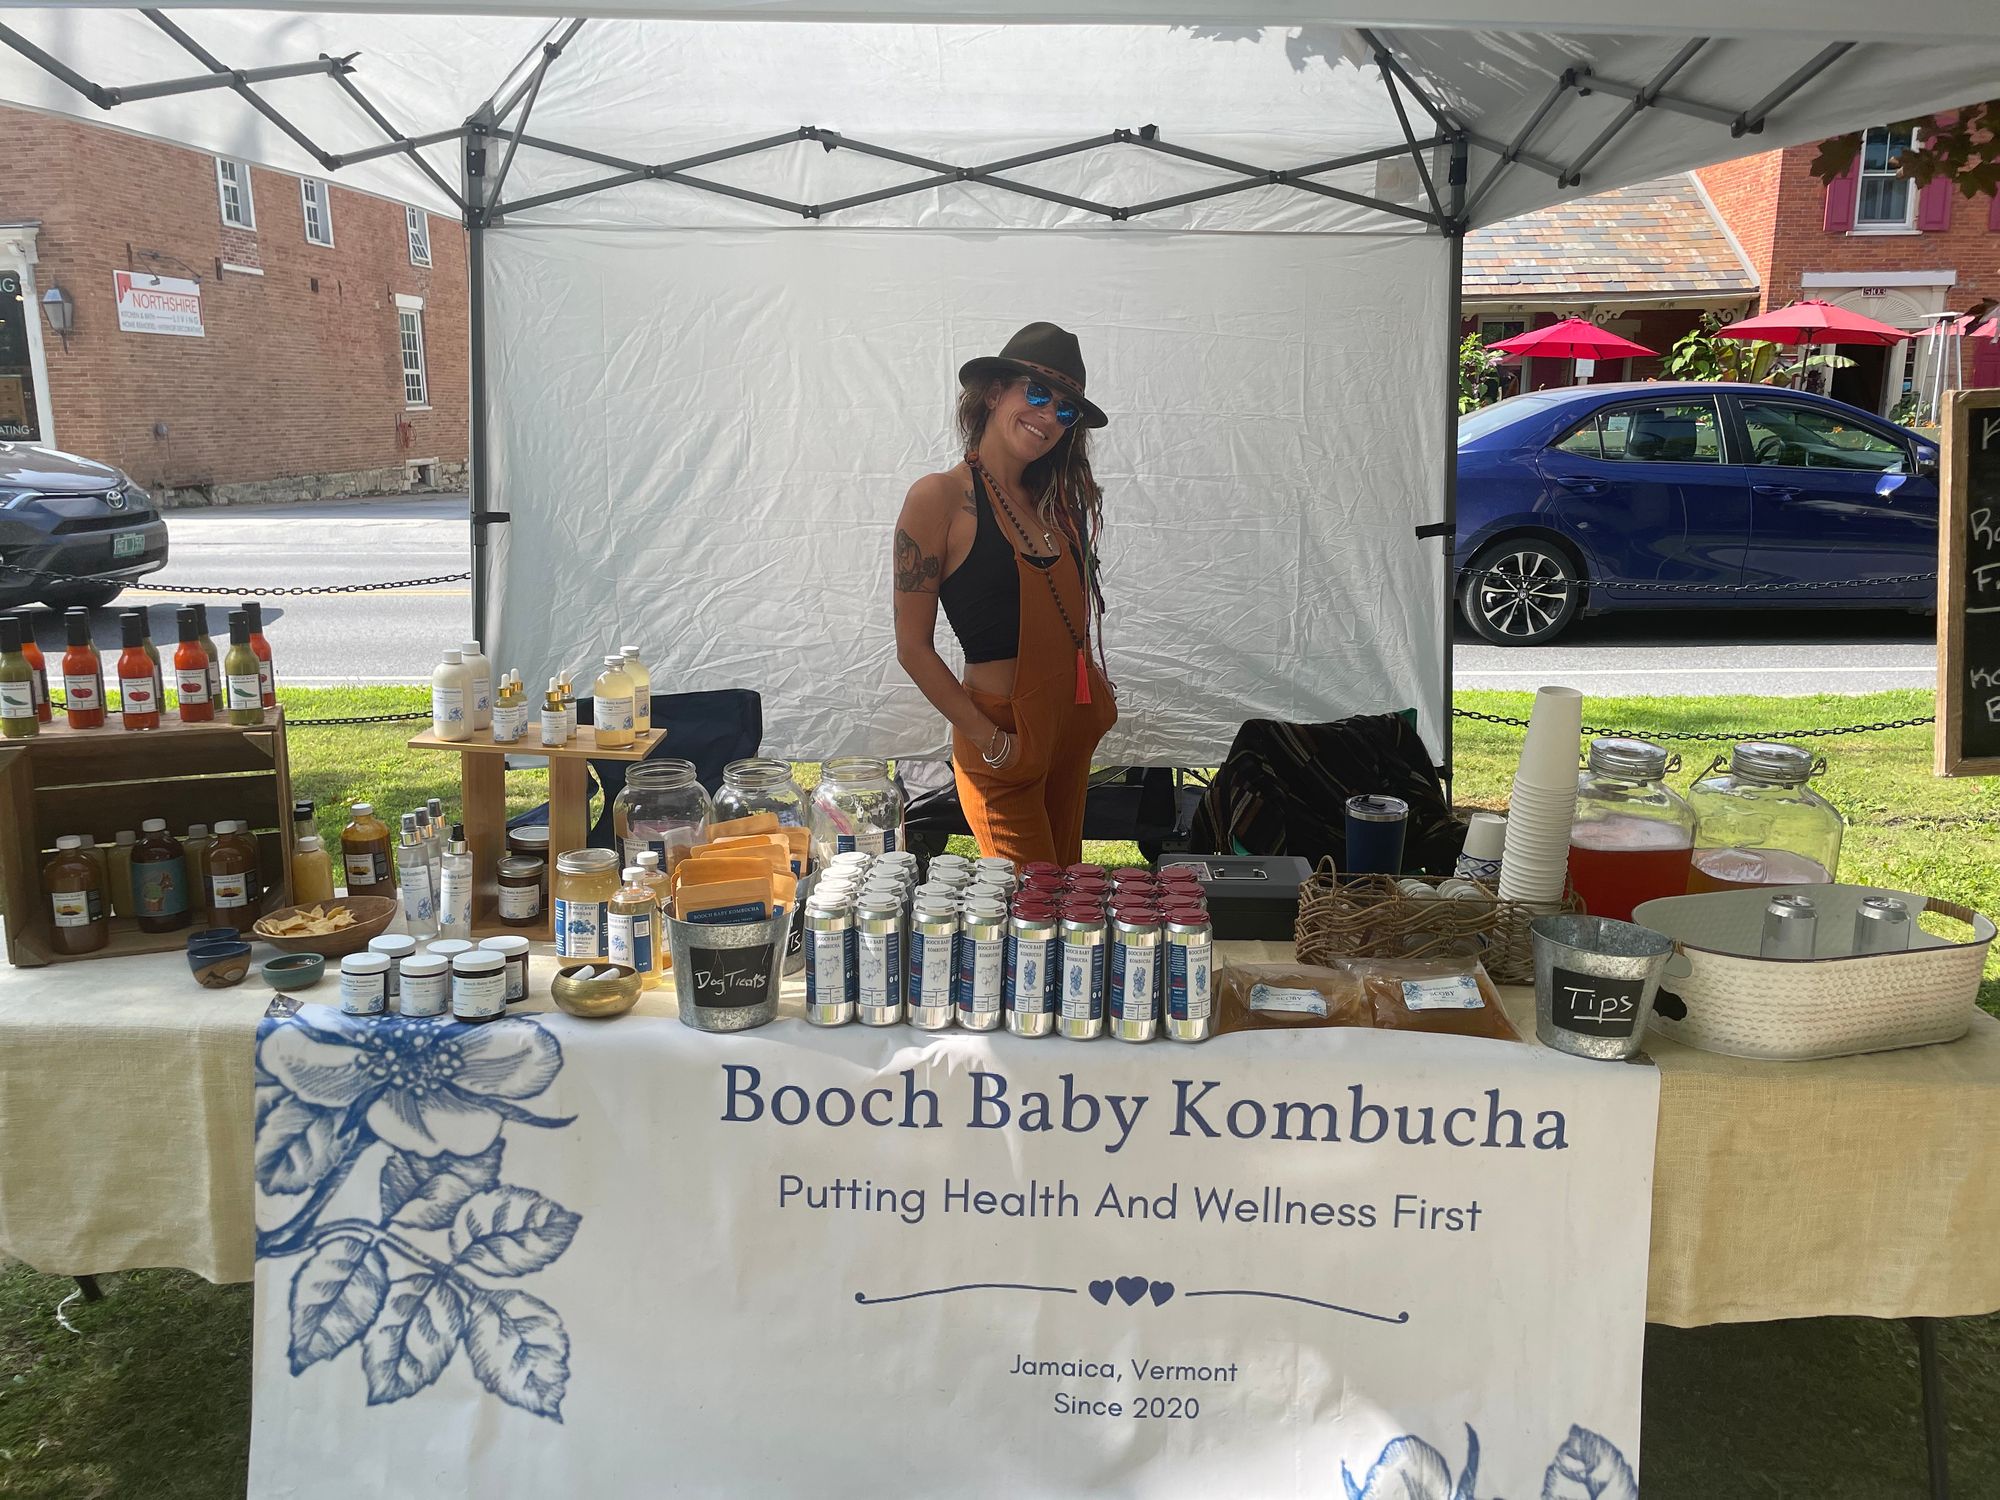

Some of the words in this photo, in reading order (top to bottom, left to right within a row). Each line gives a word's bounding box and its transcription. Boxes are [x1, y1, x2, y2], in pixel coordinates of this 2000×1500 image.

[132, 293, 198, 313] NORTHSHIRE
[728, 906, 760, 915] KOMBUCHA
[695, 971, 725, 996] Dog
[725, 968, 766, 989] Treats
[1563, 986, 1634, 1024] Tips
[720, 1064, 943, 1129] Booch
[967, 1070, 1150, 1154] Baby
[1170, 1079, 1570, 1151] Kombucha
[780, 1175, 925, 1225] Putting
[944, 1177, 1079, 1218] Health
[1095, 1182, 1178, 1220] And
[1193, 1185, 1377, 1228] Wellness
[1393, 1193, 1483, 1232] First
[1010, 1353, 1123, 1383] Jamaica,
[1130, 1359, 1239, 1382] Vermont
[1053, 1392, 1122, 1418] Since
[1133, 1396, 1200, 1420] 2020
